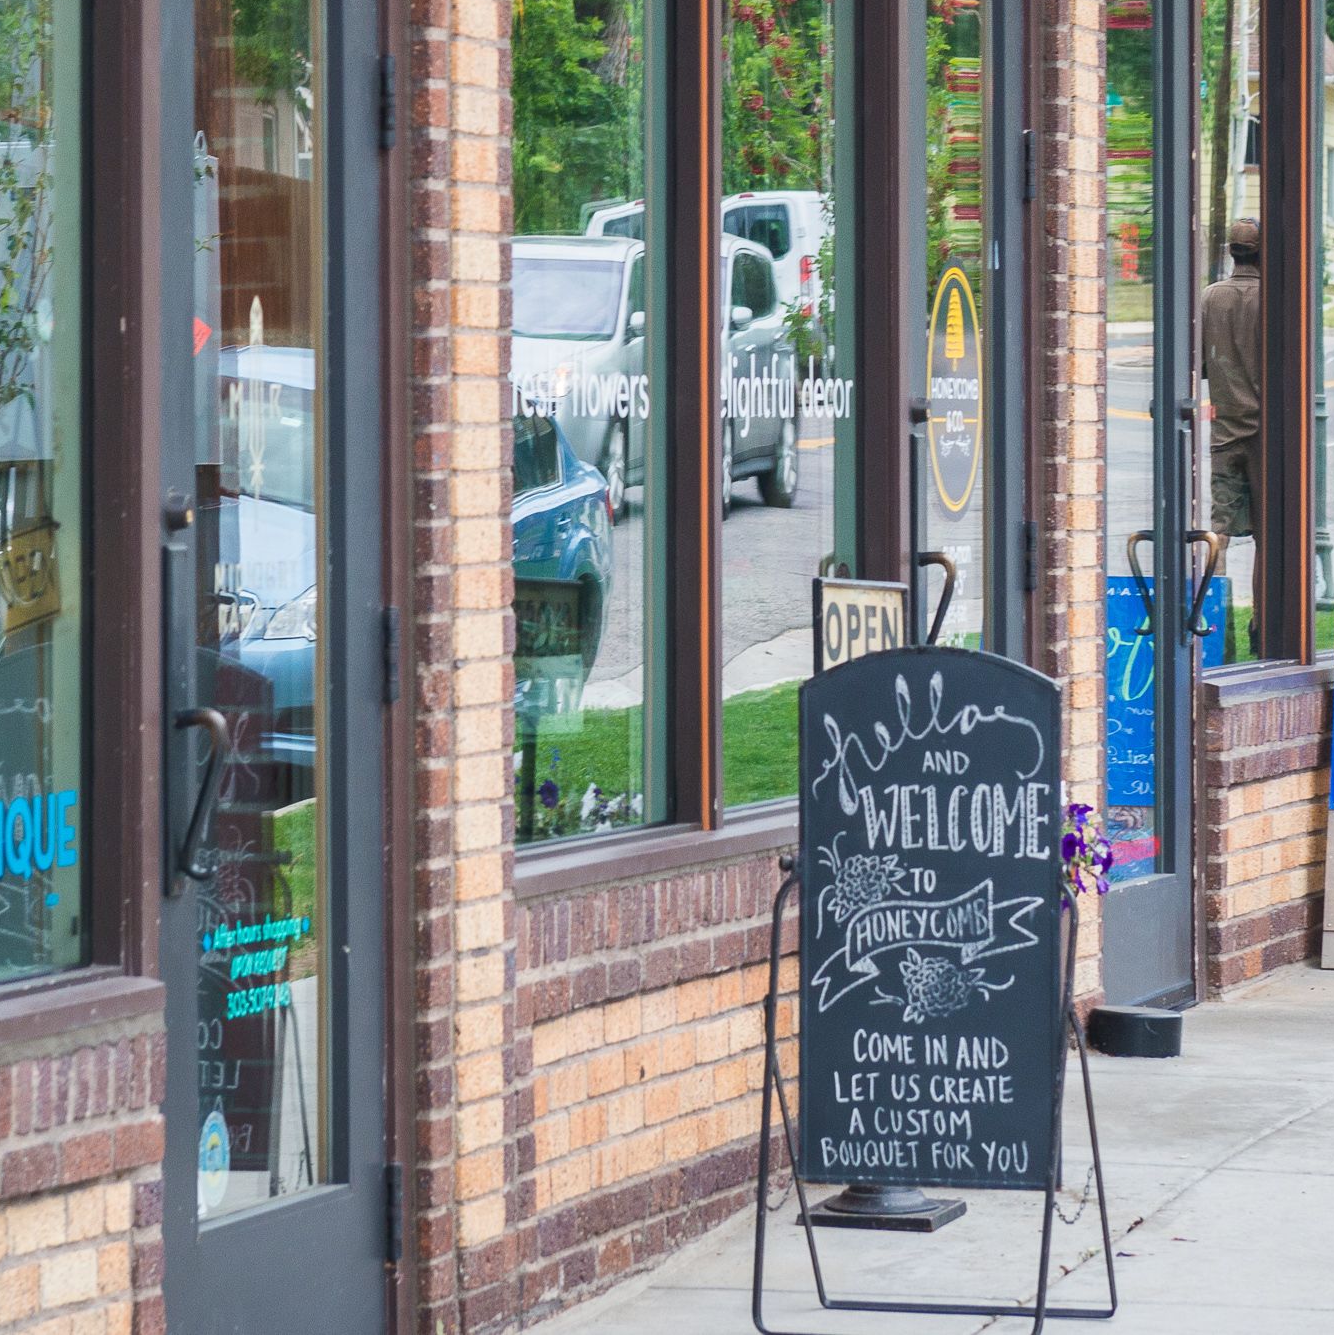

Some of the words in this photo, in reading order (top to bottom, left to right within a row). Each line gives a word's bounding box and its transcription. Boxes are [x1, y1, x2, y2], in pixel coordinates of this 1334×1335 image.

[570, 352, 650, 419] flowers
[801, 354, 854, 418] decor
[931, 376, 979, 400] HONEYCOMB
[825, 601, 899, 662] OPEN
[812, 671, 1045, 815] hello
[922, 750, 970, 775] AND
[858, 782, 1050, 860] WELCOME
[910, 867, 937, 894] TO
[236, 919, 262, 945] hours
[855, 898, 988, 953] HONEYCOMB
[853, 1028, 915, 1065] COME
[925, 1034, 948, 1065] IN
[955, 1036, 1009, 1070] AND
[833, 1070, 880, 1103] LET
[891, 1073, 920, 1103] US
[929, 1074, 1014, 1105] CREATE
[848, 1107, 865, 1136] A
[874, 1106, 972, 1141] CUSTOM
[820, 1136, 919, 1169] BOUQUET
[931, 1144, 975, 1170] FOR
[981, 1140, 1029, 1175] YOU
